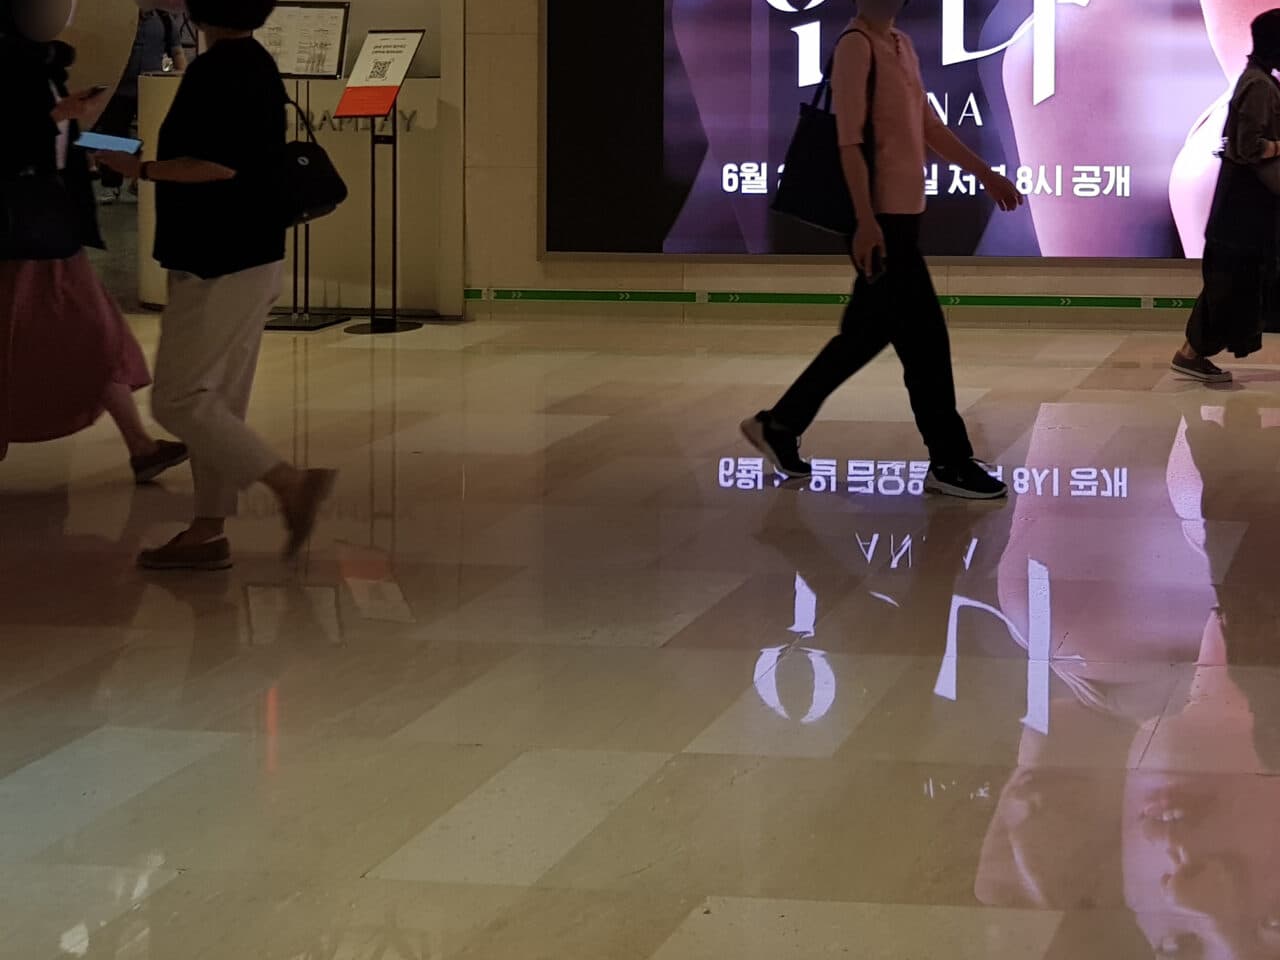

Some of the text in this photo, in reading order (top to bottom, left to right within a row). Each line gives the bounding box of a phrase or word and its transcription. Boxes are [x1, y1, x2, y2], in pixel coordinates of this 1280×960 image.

[722, 162, 768, 194] 6월
[1016, 165, 1062, 196] 8시
[1072, 164, 1131, 197] 공개
